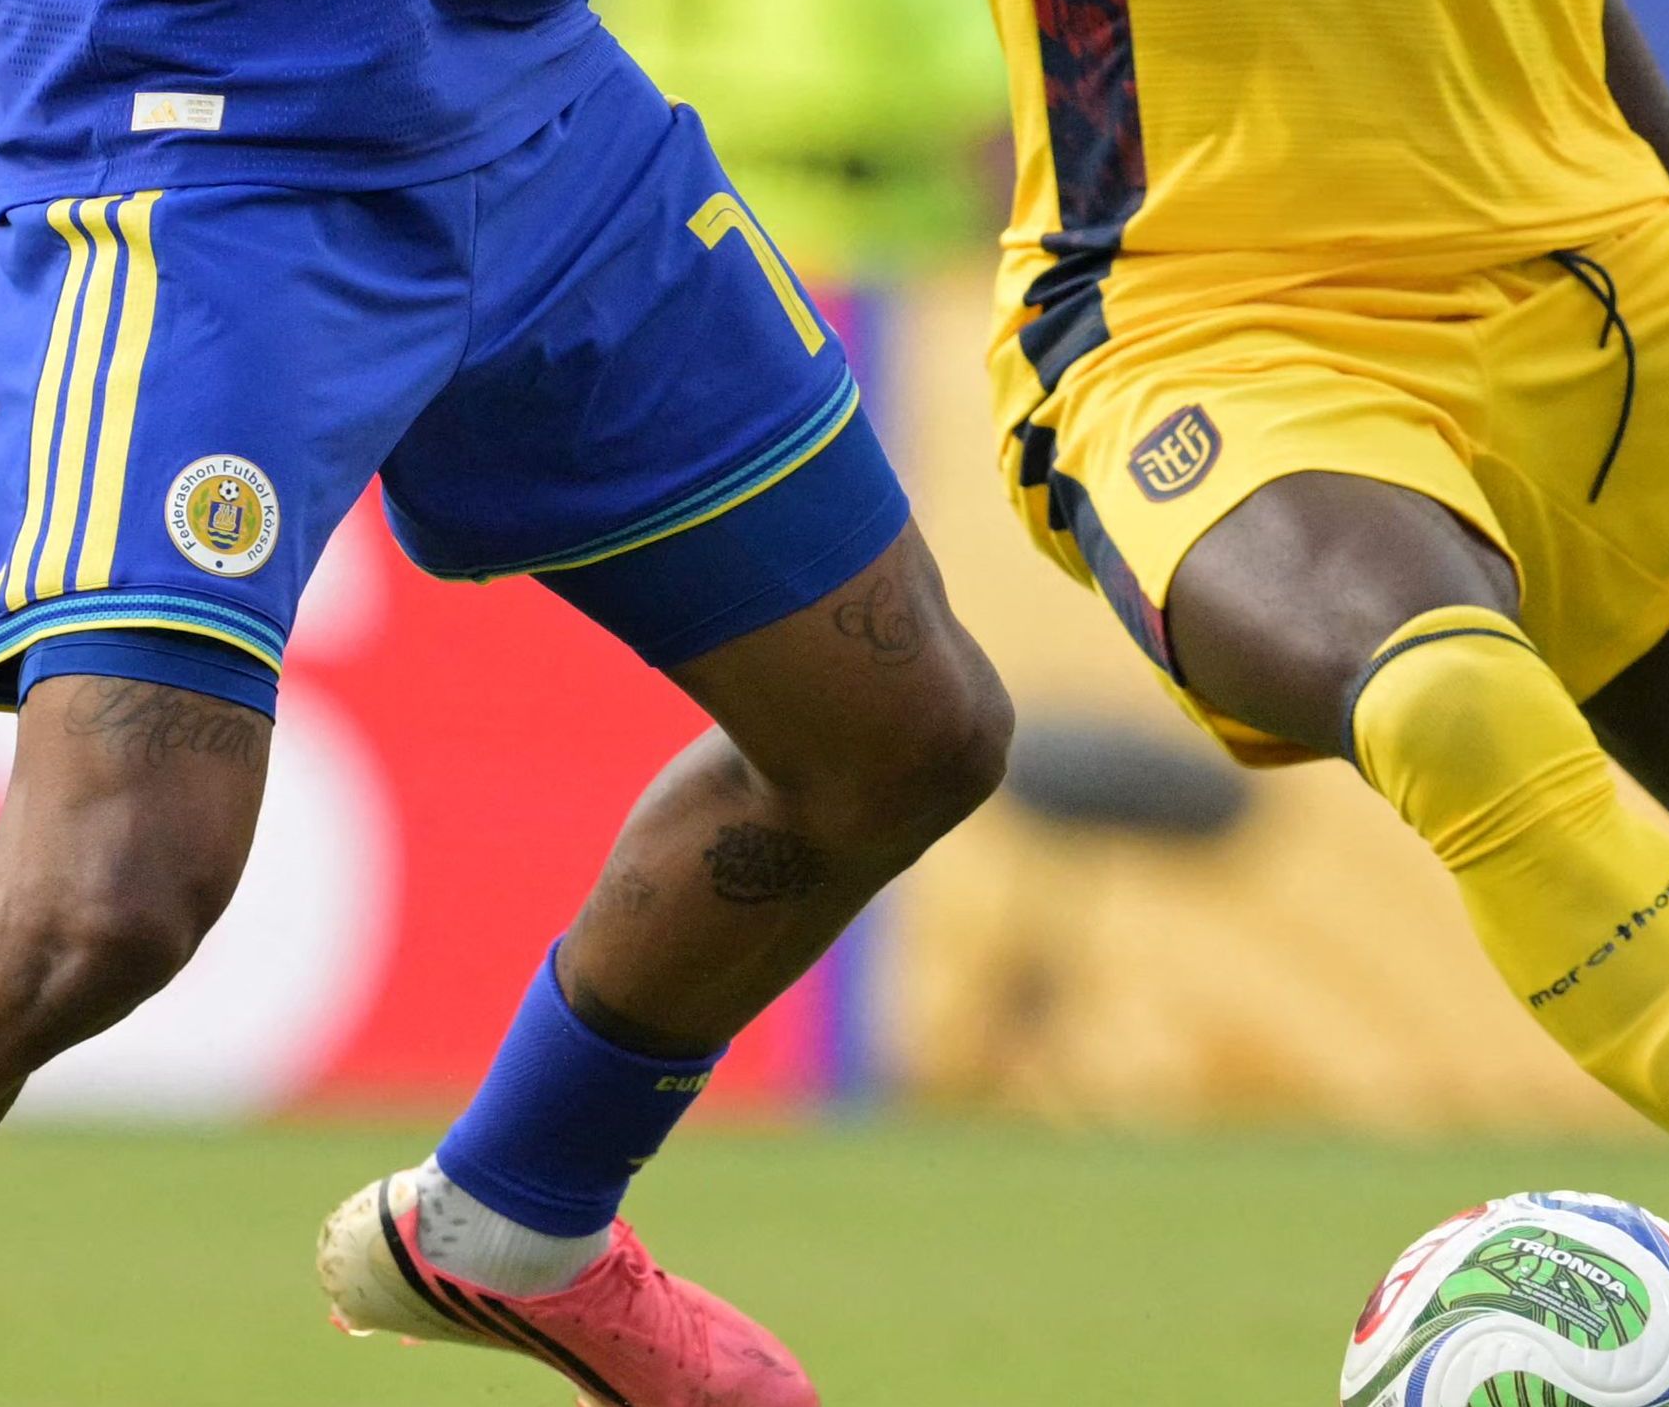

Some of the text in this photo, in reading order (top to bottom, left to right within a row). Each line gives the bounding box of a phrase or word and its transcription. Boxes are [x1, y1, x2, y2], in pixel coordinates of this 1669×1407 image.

[686, 192, 825, 358] 7
[172, 464, 216, 551] Federashon
[1510, 1237, 1627, 1300] TRIONDA
